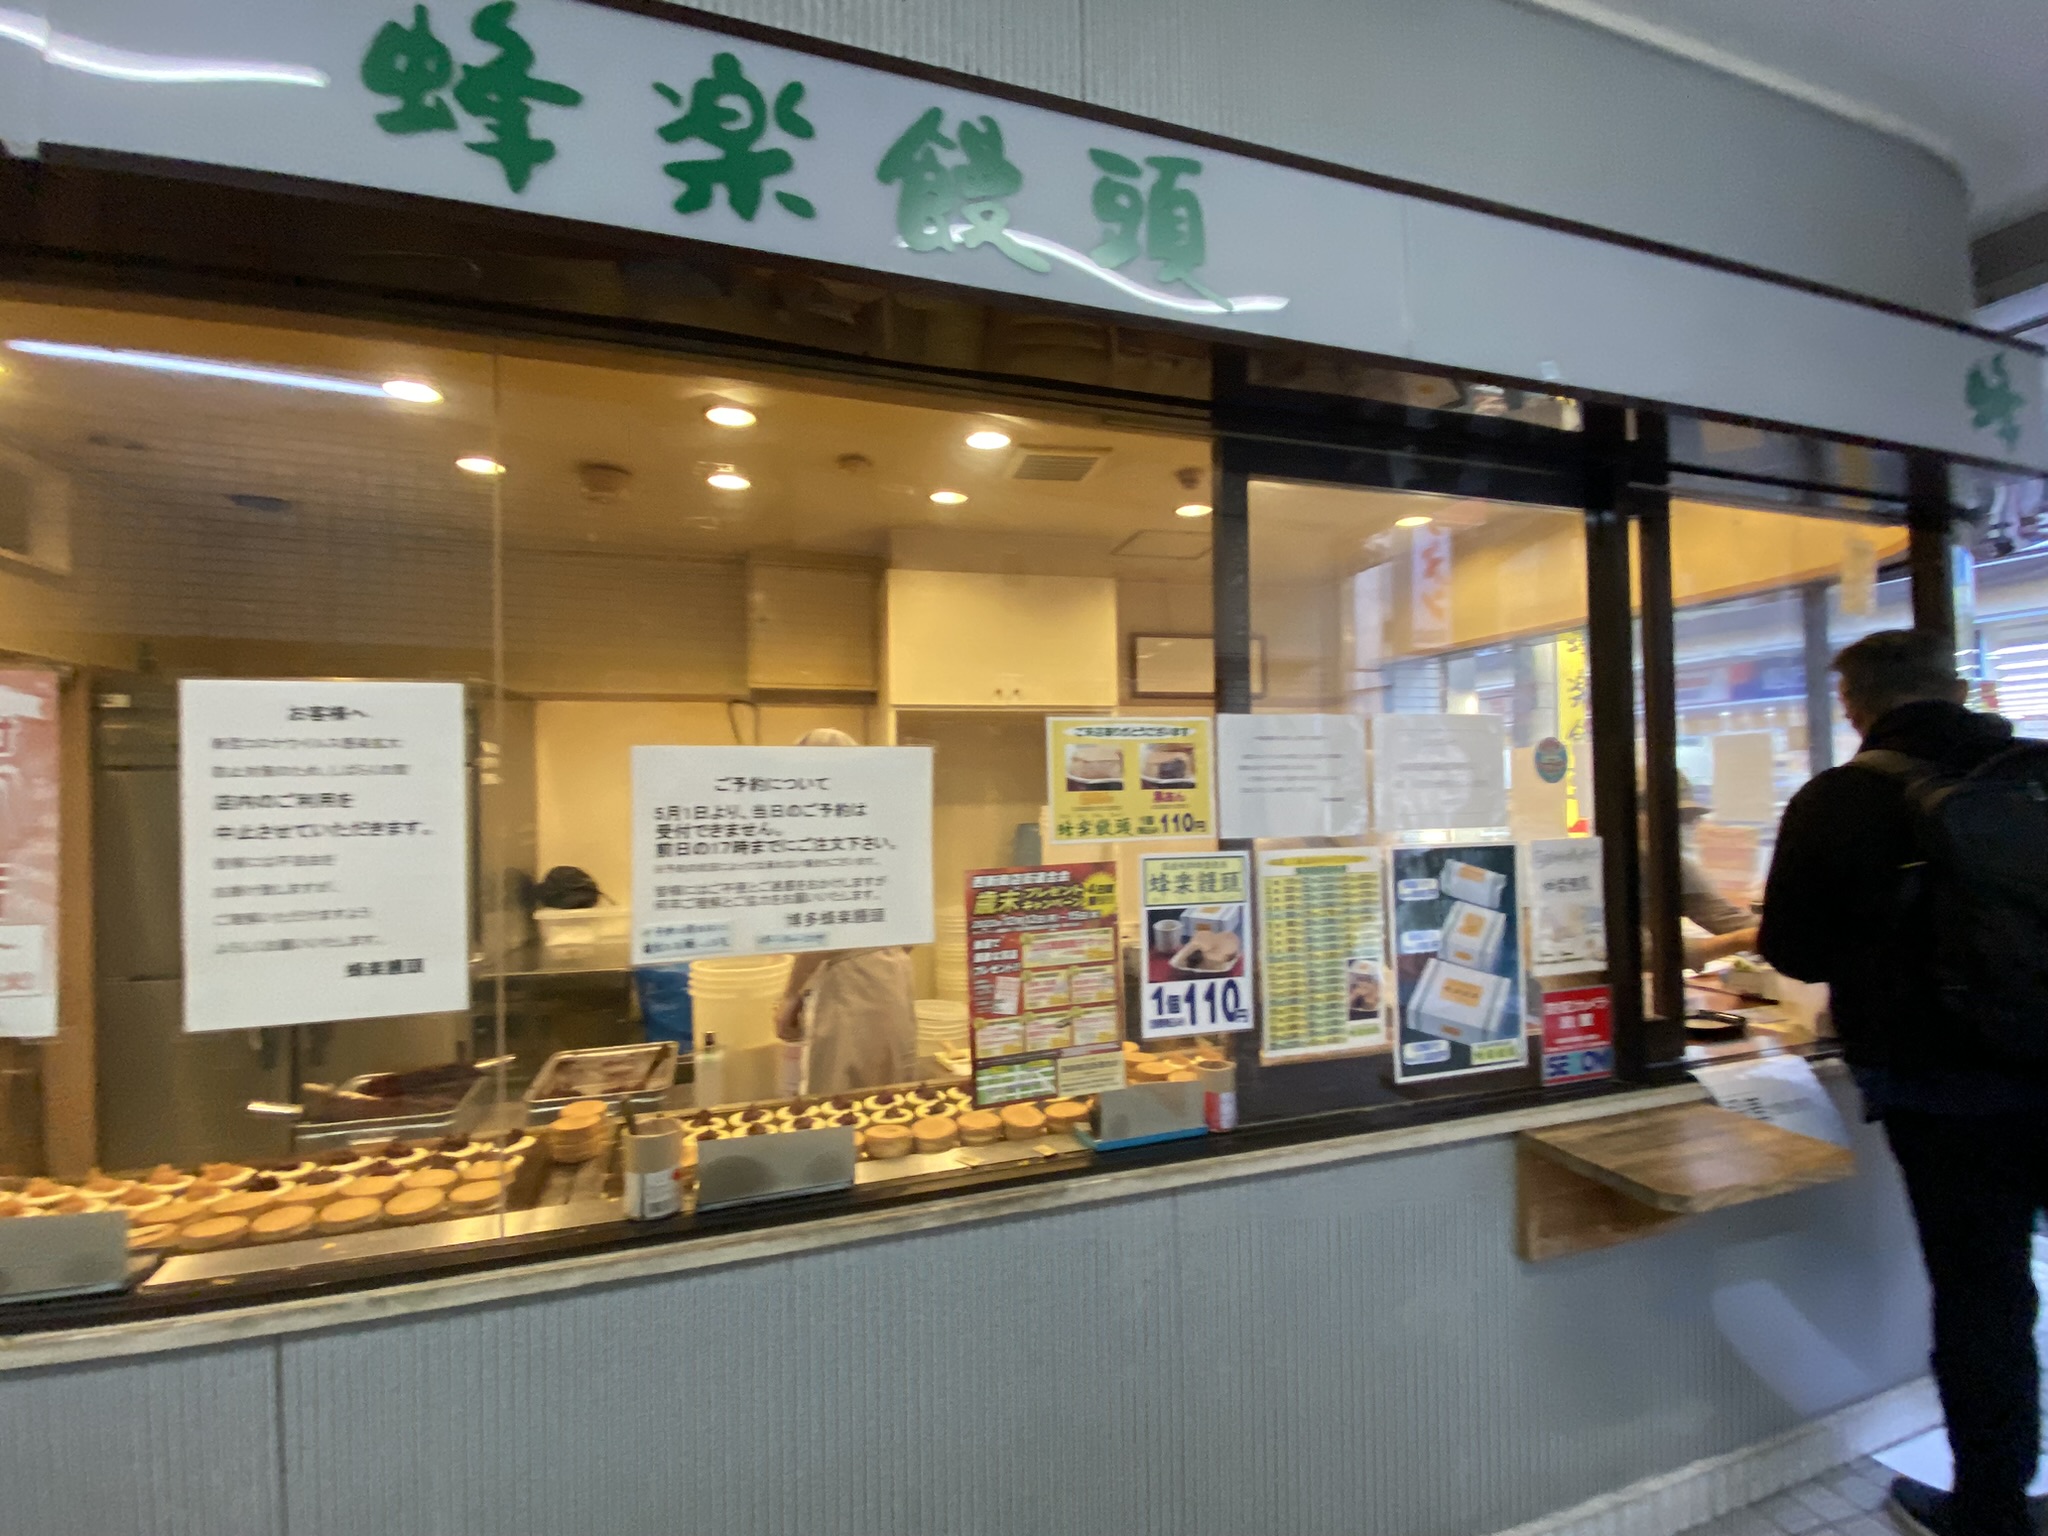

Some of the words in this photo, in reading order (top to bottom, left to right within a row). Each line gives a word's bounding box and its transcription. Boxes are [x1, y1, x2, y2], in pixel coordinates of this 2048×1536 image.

[361, 1, 1233, 309] 蜂楽饅頭
[714, 776, 831, 793] ご予約について
[654, 802, 869, 821] 5月1日より、当日のご予約は
[656, 823, 784, 841] 受付できません。
[655, 837, 897, 858] 前日の17時までにご注文下さい。
